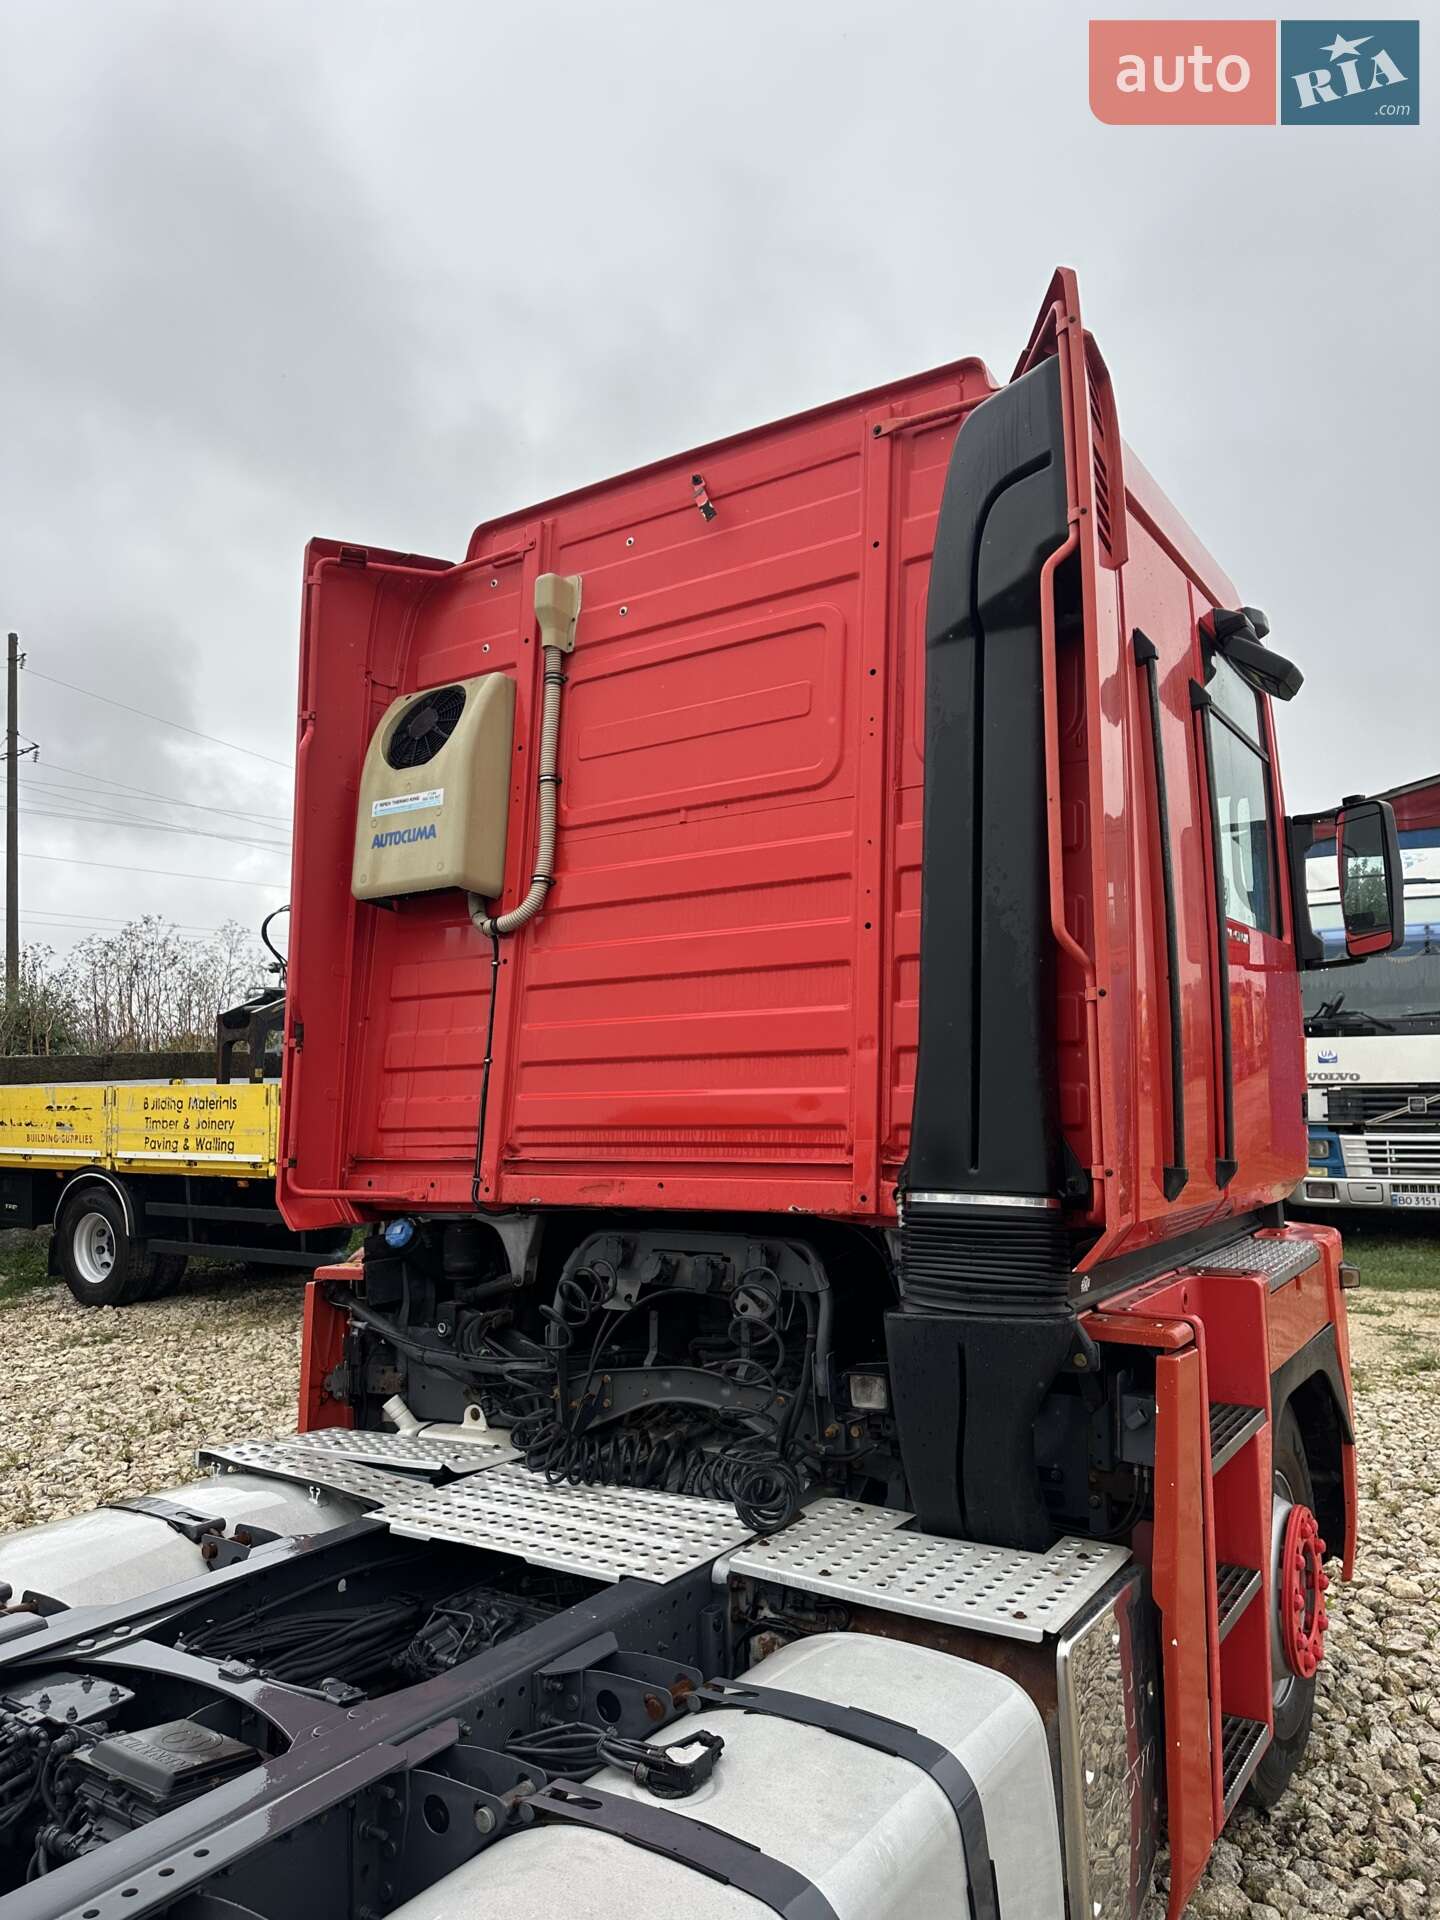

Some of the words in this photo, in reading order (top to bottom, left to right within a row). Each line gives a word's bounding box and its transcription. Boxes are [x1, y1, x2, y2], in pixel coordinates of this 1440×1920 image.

[372, 824, 437, 849] AUTOCLIMA
[1321, 1050, 1334, 1058] UA
[1308, 1072, 1361, 1081] VOLVO
[144, 1096, 184, 1113] Building
[188, 1096, 238, 1111] Materials
[145, 1116, 179, 1130] Timber
[183, 1118, 190, 1130] &
[195, 1116, 235, 1134] Joinery
[26, 1133, 59, 1143] BUILDING
[61, 1134, 94, 1144] SUPPLIES
[144, 1136, 179, 1153] Paving
[183, 1137, 190, 1151] &
[195, 1137, 235, 1154] Walling
